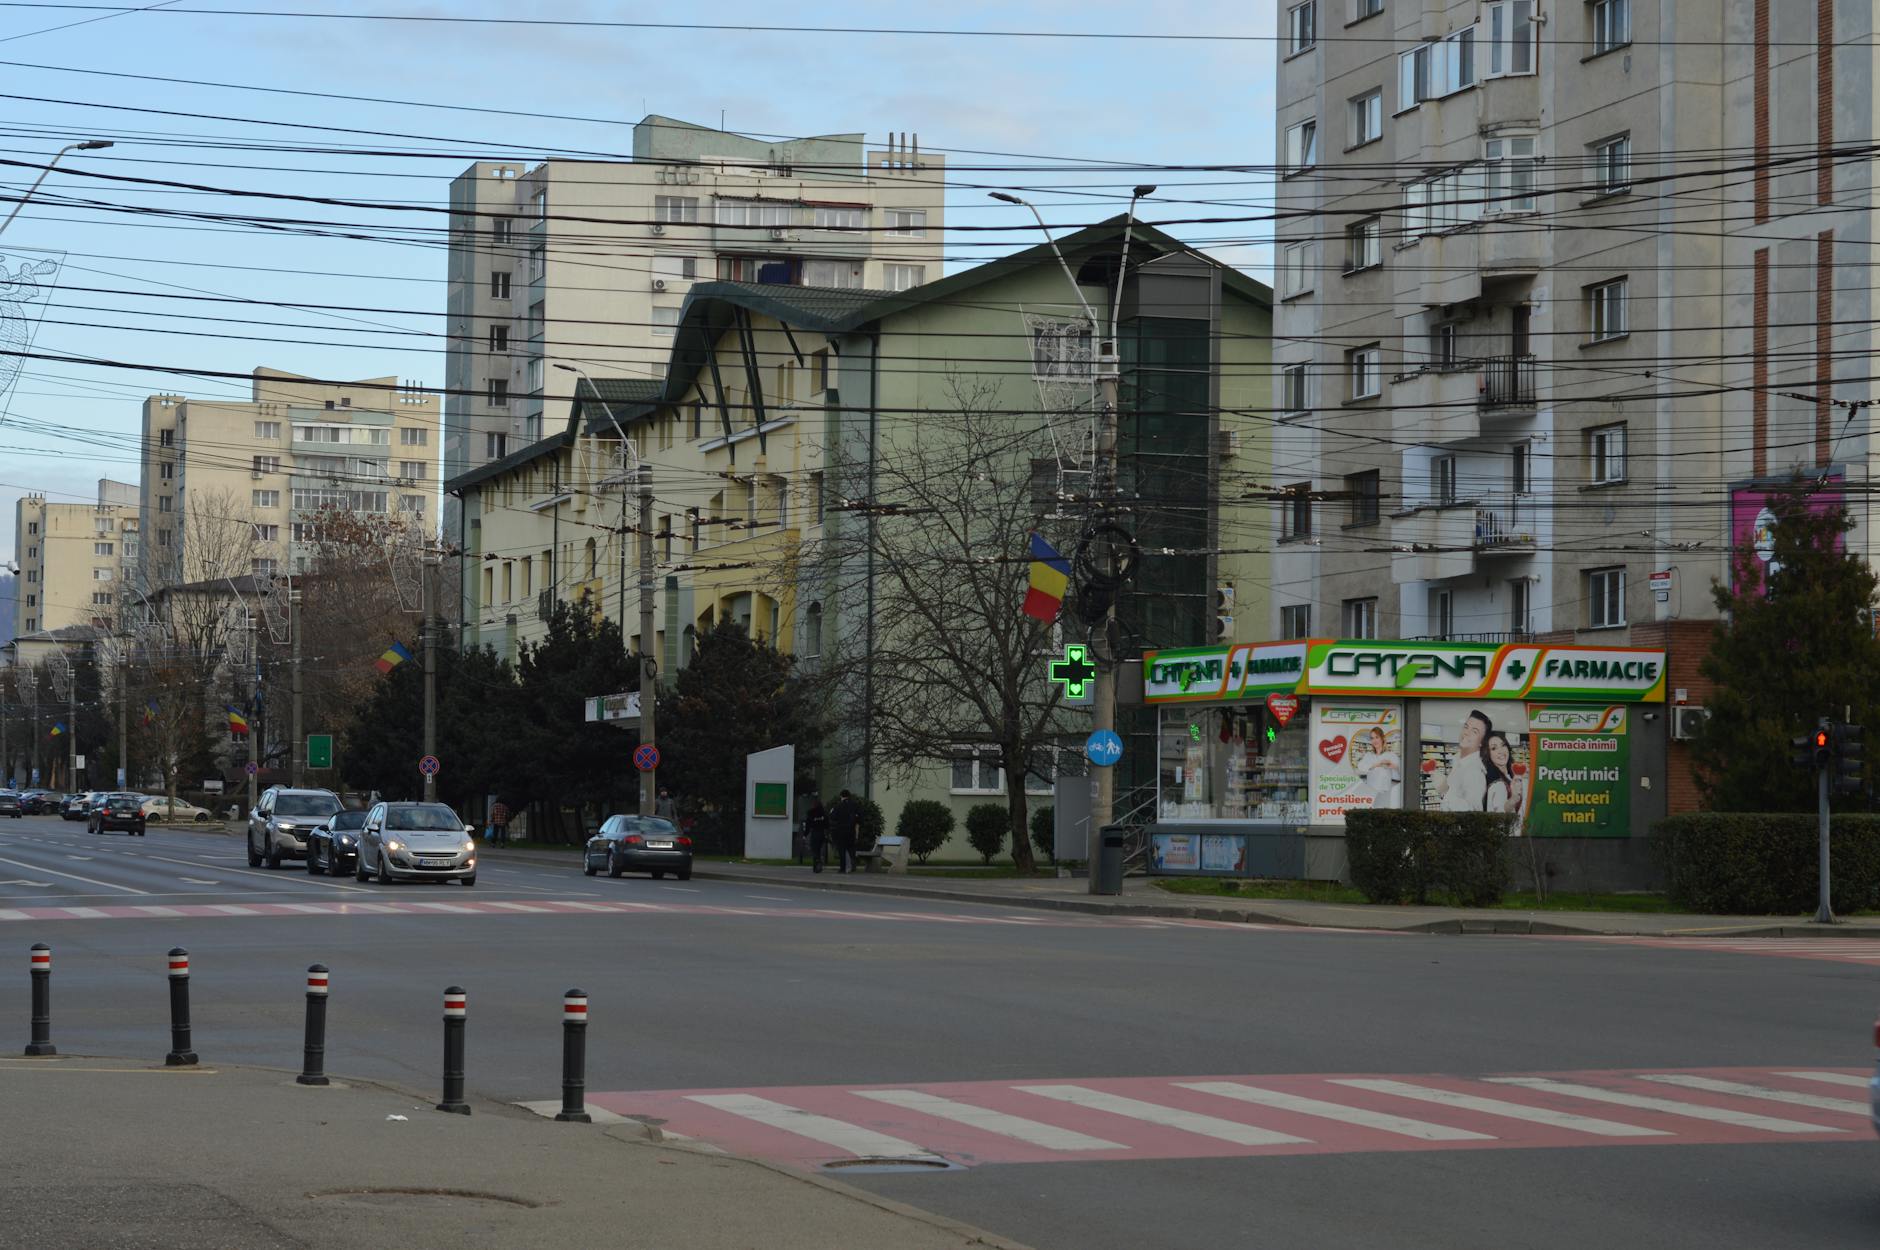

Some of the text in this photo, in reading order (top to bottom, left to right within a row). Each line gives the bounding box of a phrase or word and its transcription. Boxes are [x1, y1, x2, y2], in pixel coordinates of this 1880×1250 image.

[1150, 659, 1223, 684] CATENA
[1327, 652, 1657, 680] CATENA FARMACIE
[1329, 711, 1377, 719] CATENA
[1538, 713, 1599, 724] CATENA
[1542, 739, 1616, 750] Farmacia inimii
[1590, 766, 1619, 781] mici
[1318, 794, 1373, 804] Consiliere
[1547, 790, 1610, 804] Reduceri
[1562, 808, 1596, 823] mari
